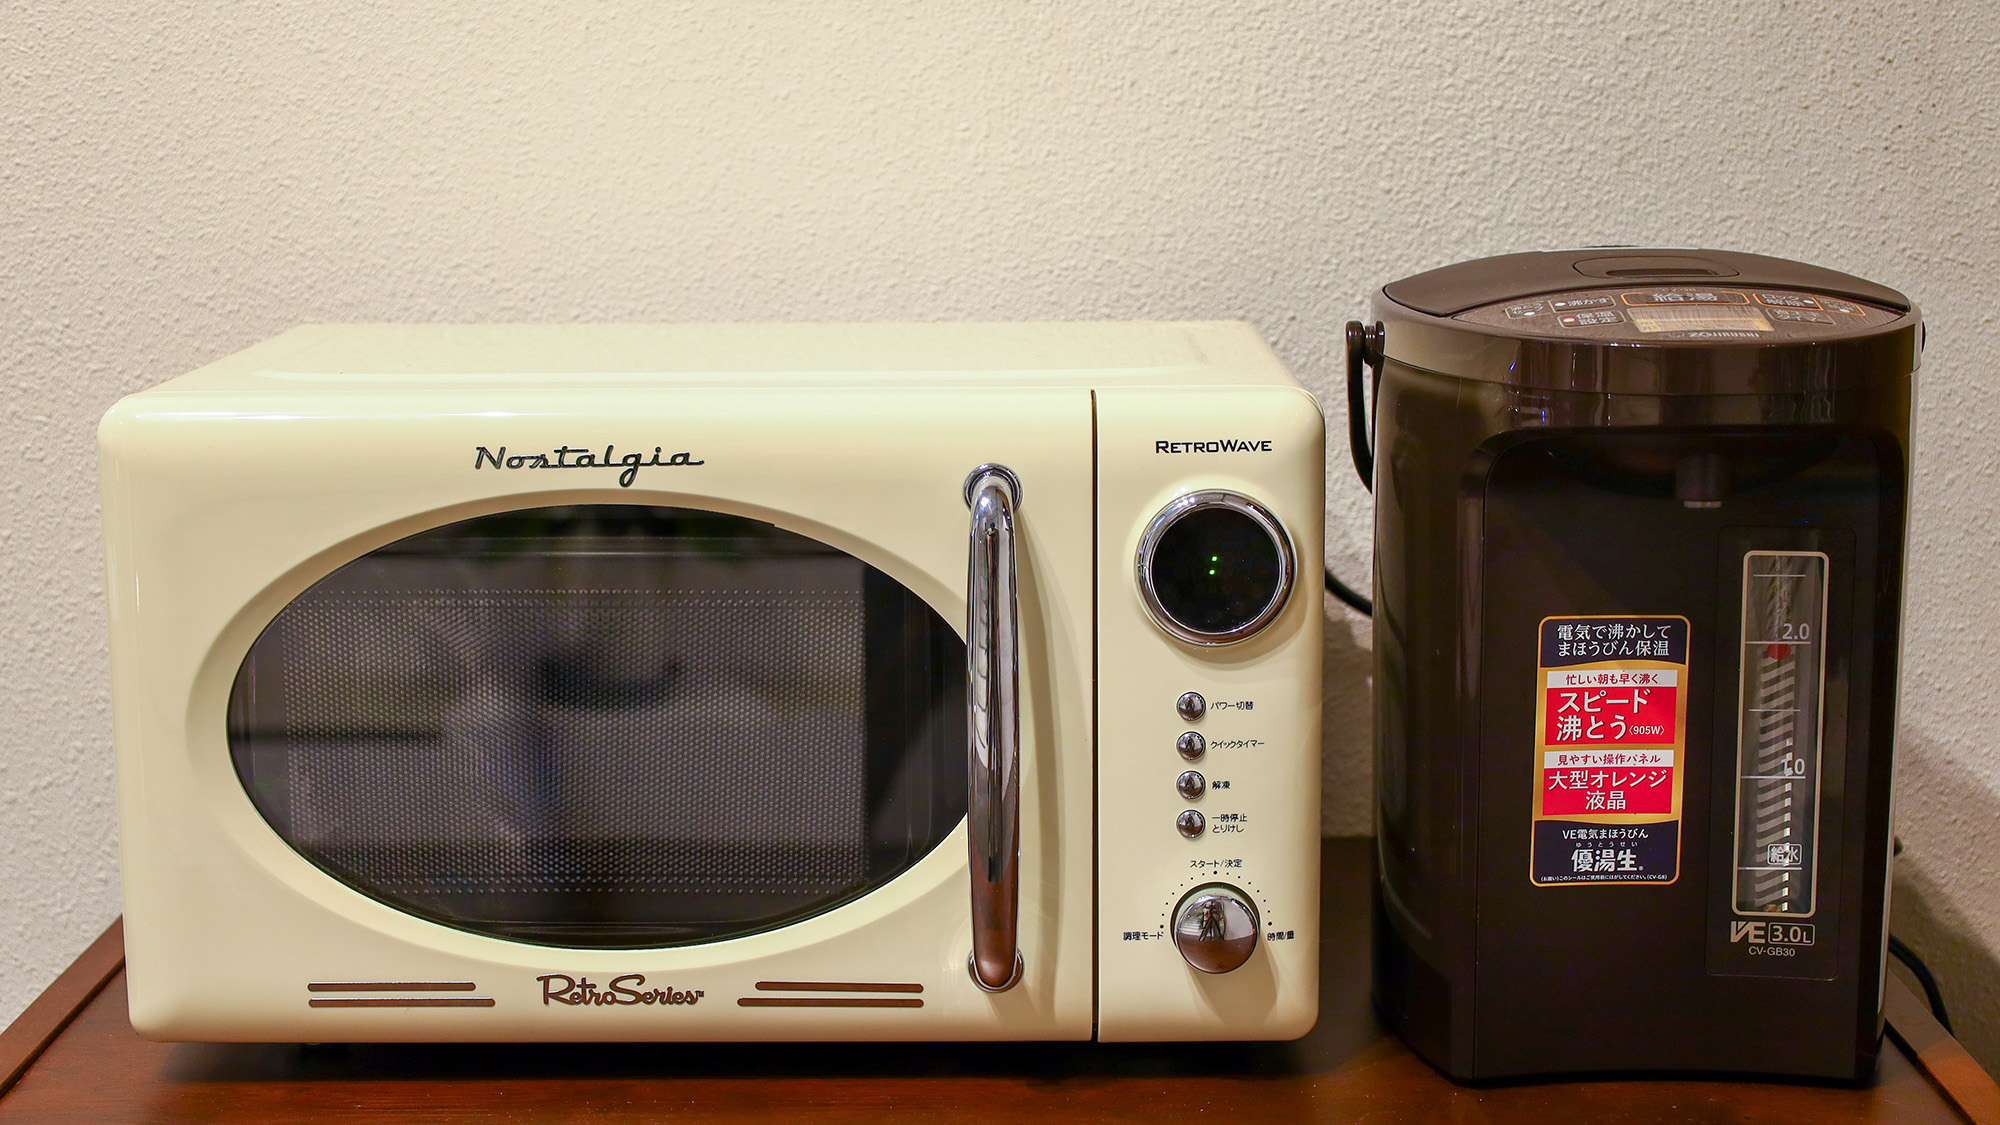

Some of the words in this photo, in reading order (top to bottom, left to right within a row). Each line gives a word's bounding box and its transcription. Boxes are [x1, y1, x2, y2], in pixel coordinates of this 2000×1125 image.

[474, 444, 705, 488] Nostalgia
[1557, 623, 1672, 640] 電気で沸かして
[1782, 623, 1810, 641] 2.0
[1557, 640, 1670, 657] まほうびん保温
[1565, 673, 1660, 686] 忙しい朝も早く沸く
[1210, 701, 1254, 711] パワー切替
[1556, 688, 1651, 715] スピード
[1210, 739, 1265, 749] クイックタイマー
[1557, 753, 1661, 766] 見やすい操作パネル
[1211, 780, 1231, 790] 解凍
[1548, 769, 1668, 791] 大型オレンジ
[1585, 790, 1628, 811] 液晶
[1211, 813, 1248, 823] 一時停止
[1212, 824, 1245, 834] とりけし
[1562, 828, 1649, 840] VE電気まほうびん
[1770, 846, 1799, 863] 給水
[1190, 858, 1243, 869] スタート/決定
[1123, 931, 1164, 941] 調理モード
[1266, 930, 1295, 942] 時間/量
[1730, 921, 1766, 944] VE
[1748, 946, 1796, 957] CV-GB30
